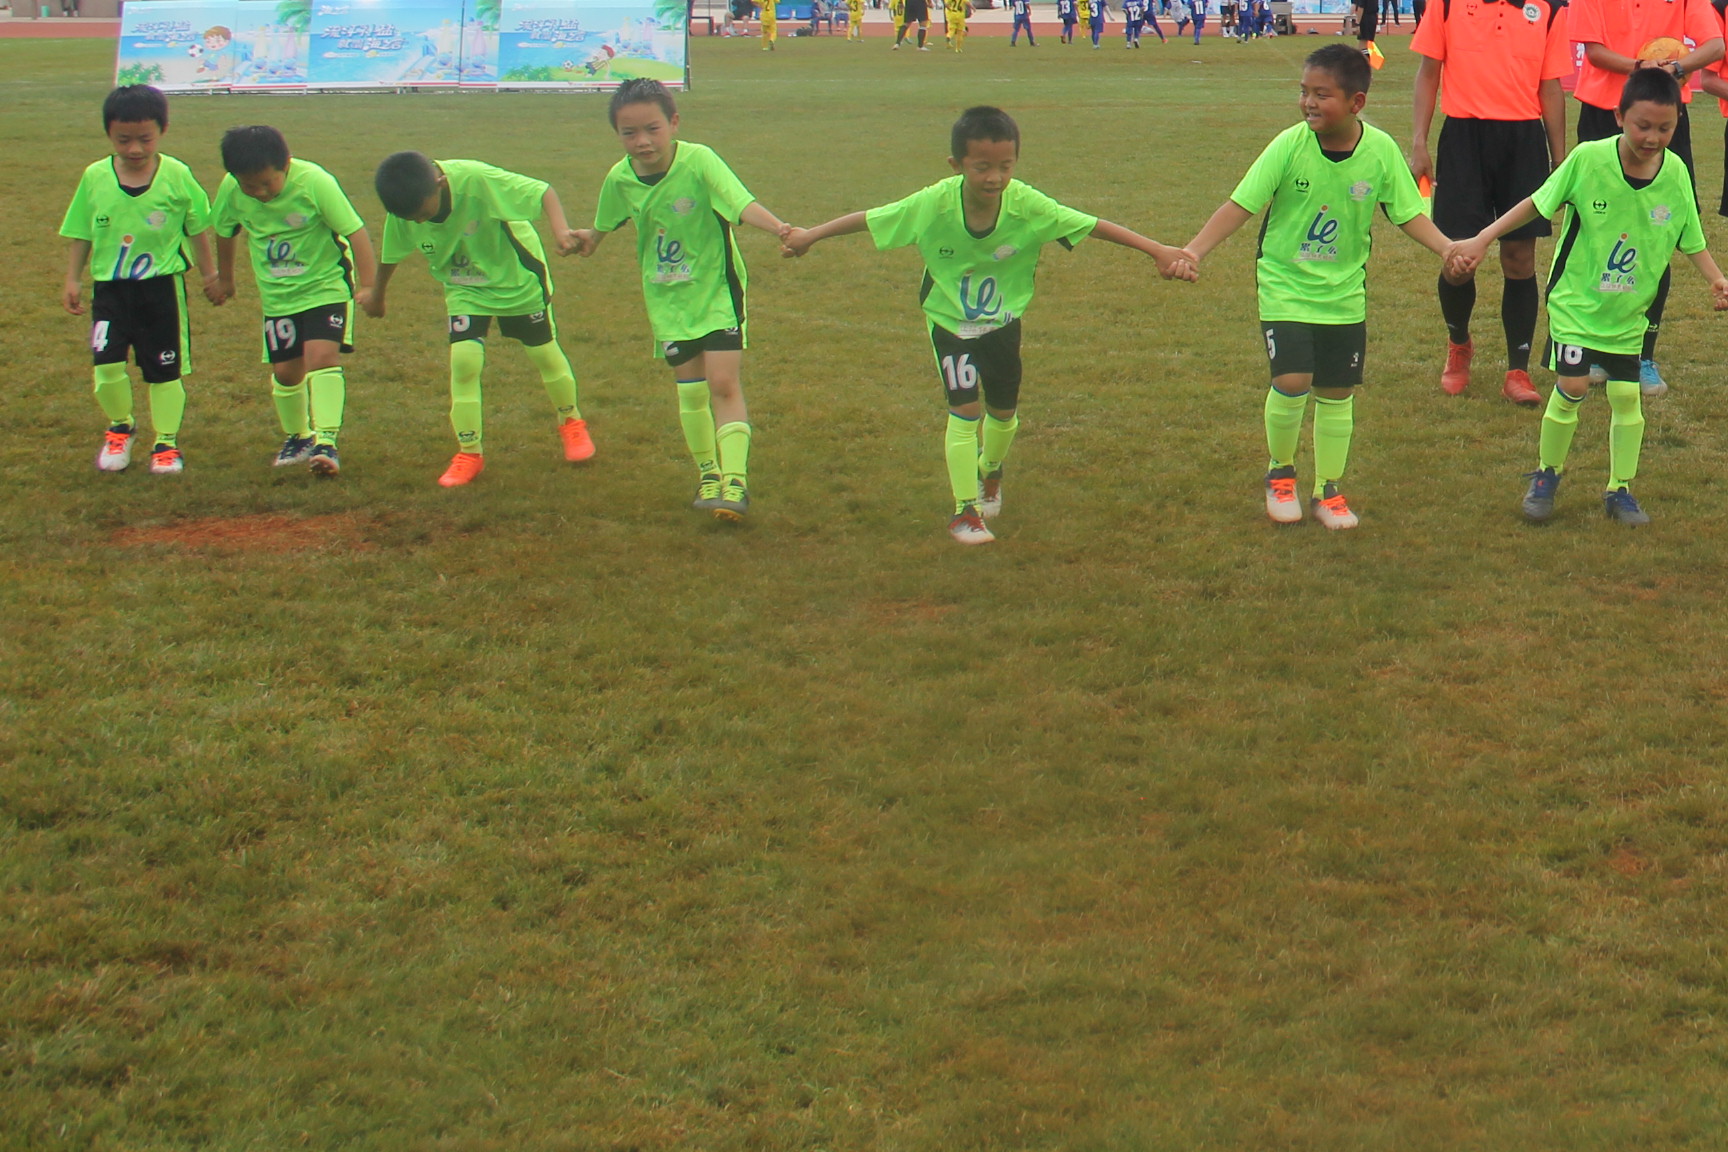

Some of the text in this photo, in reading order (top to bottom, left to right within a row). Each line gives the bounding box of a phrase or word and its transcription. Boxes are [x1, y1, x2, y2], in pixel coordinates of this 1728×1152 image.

[1128, 5, 1141, 21] 12
[1194, 1, 1204, 14] 11
[265, 317, 298, 351] 19
[1265, 328, 1277, 360] 5
[942, 353, 978, 391] 16
